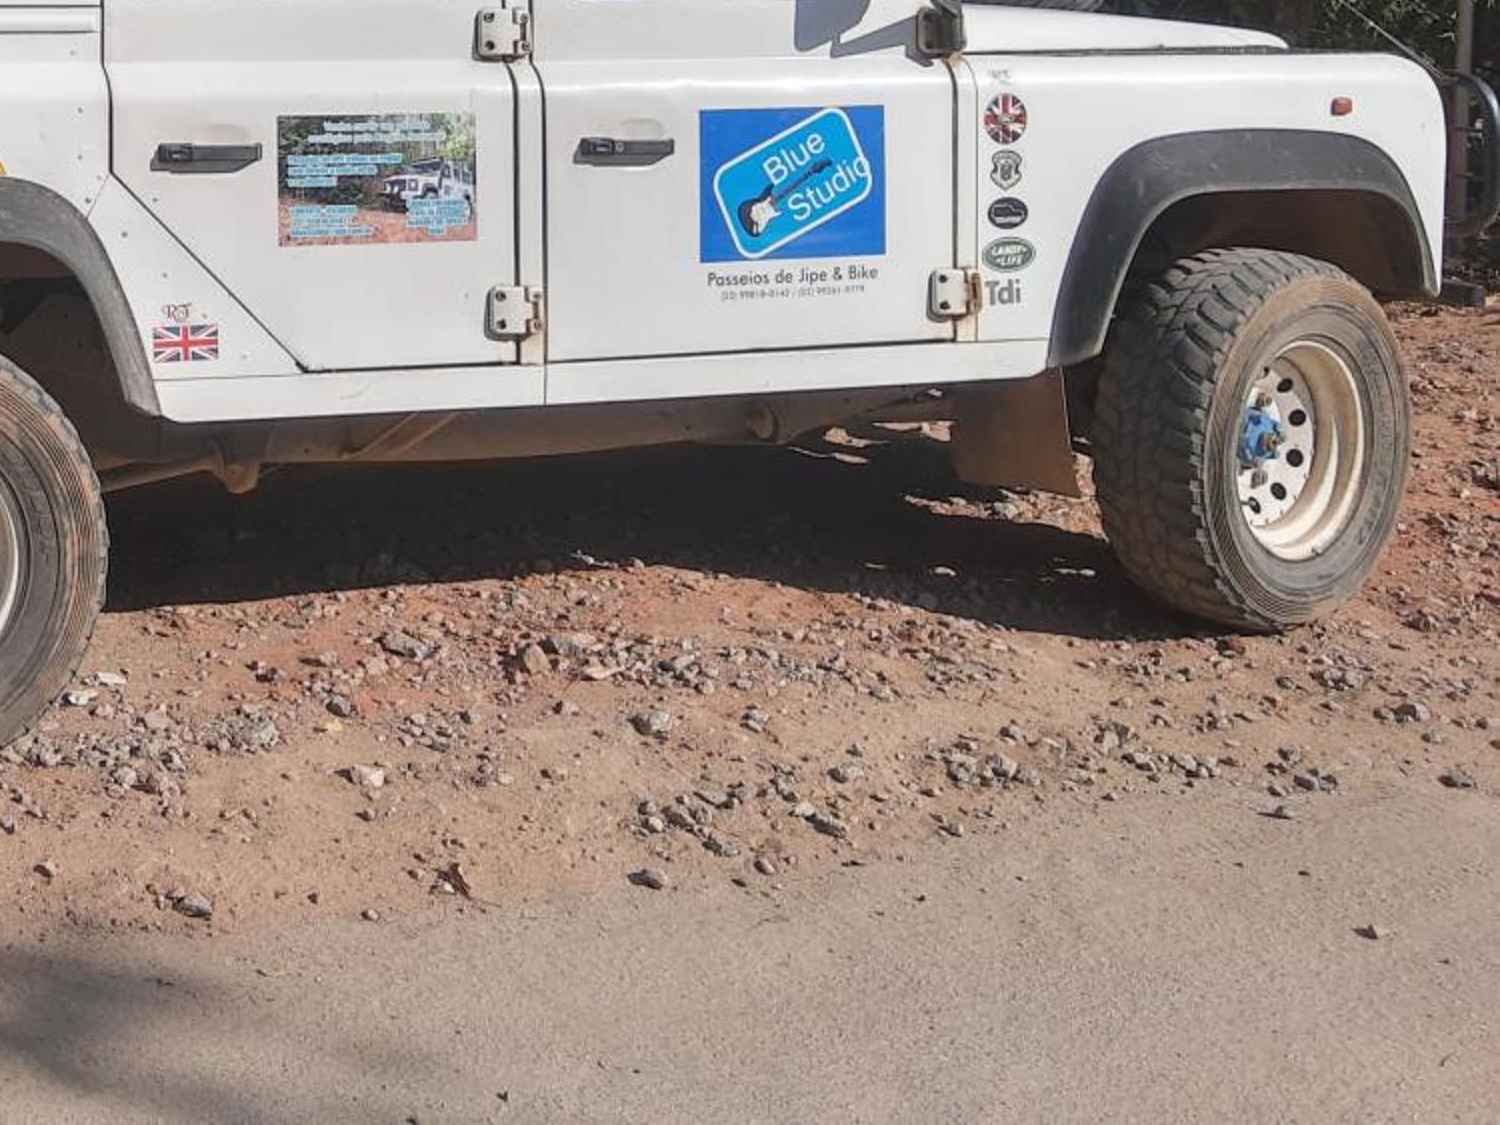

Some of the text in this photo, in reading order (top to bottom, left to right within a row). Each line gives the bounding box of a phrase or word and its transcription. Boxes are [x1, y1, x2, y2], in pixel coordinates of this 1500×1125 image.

[763, 133, 825, 185] Blue
[787, 155, 870, 221] Studio
[707, 264, 879, 287] Passeios de Jipe & Bike
[984, 278, 1021, 305] Tdi
